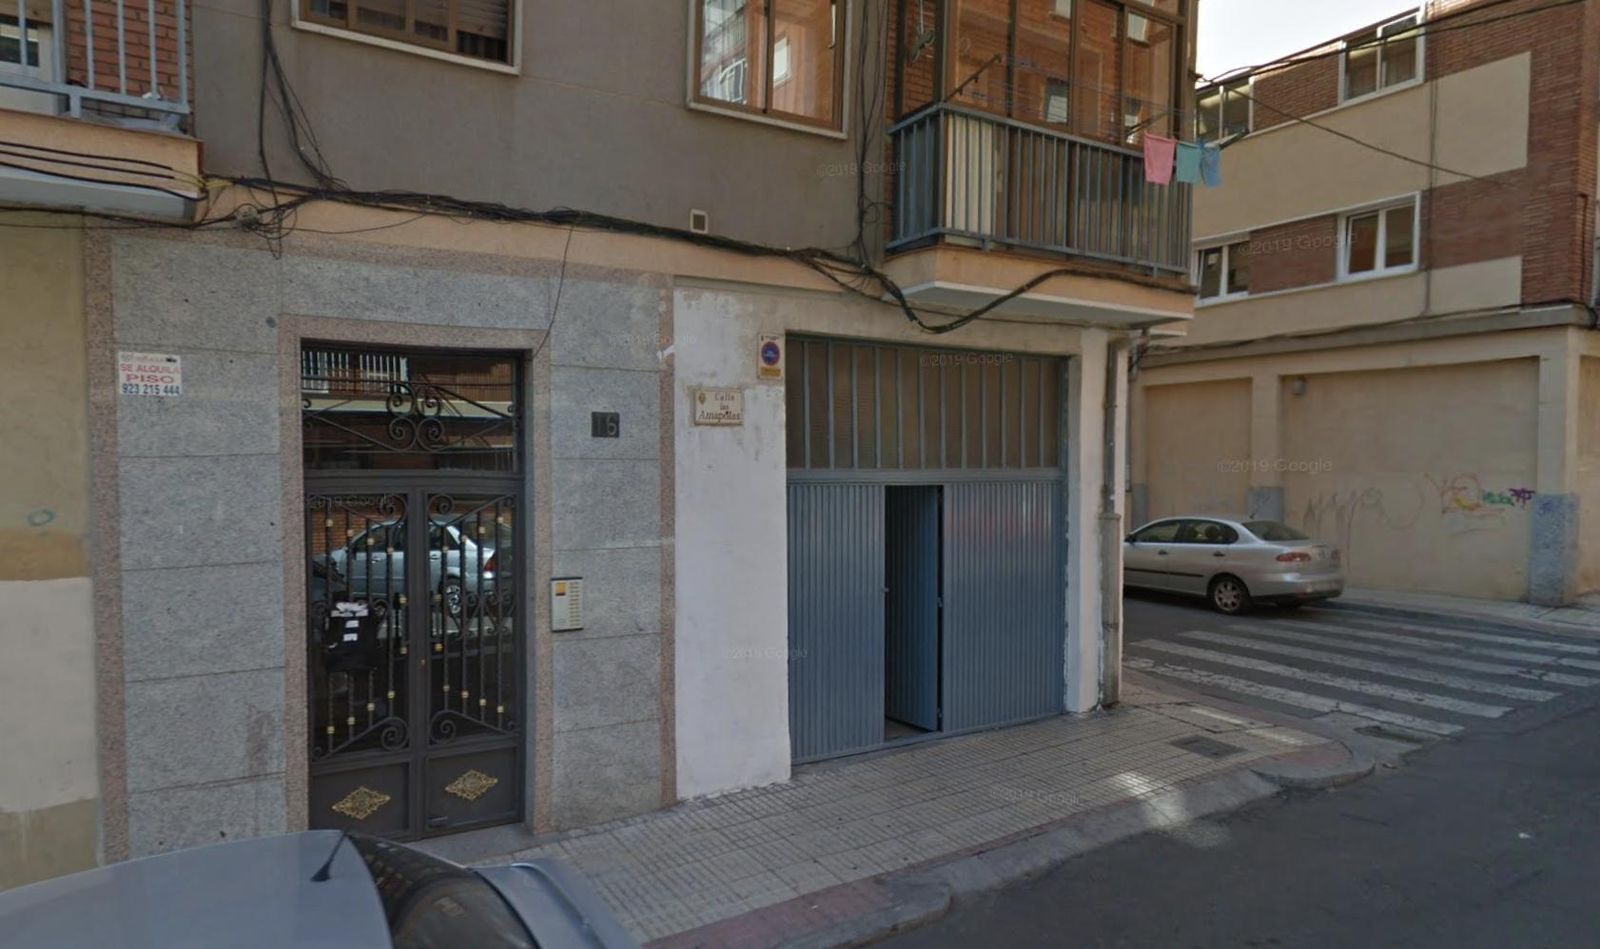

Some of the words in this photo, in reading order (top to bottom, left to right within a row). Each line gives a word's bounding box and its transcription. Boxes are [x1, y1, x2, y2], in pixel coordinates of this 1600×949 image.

[121, 364, 133, 373] SE
[126, 373, 174, 384] PISO
[122, 383, 140, 394] 923
[143, 384, 160, 395] 215
[163, 385, 180, 395] 444
[714, 391, 735, 401] Calle
